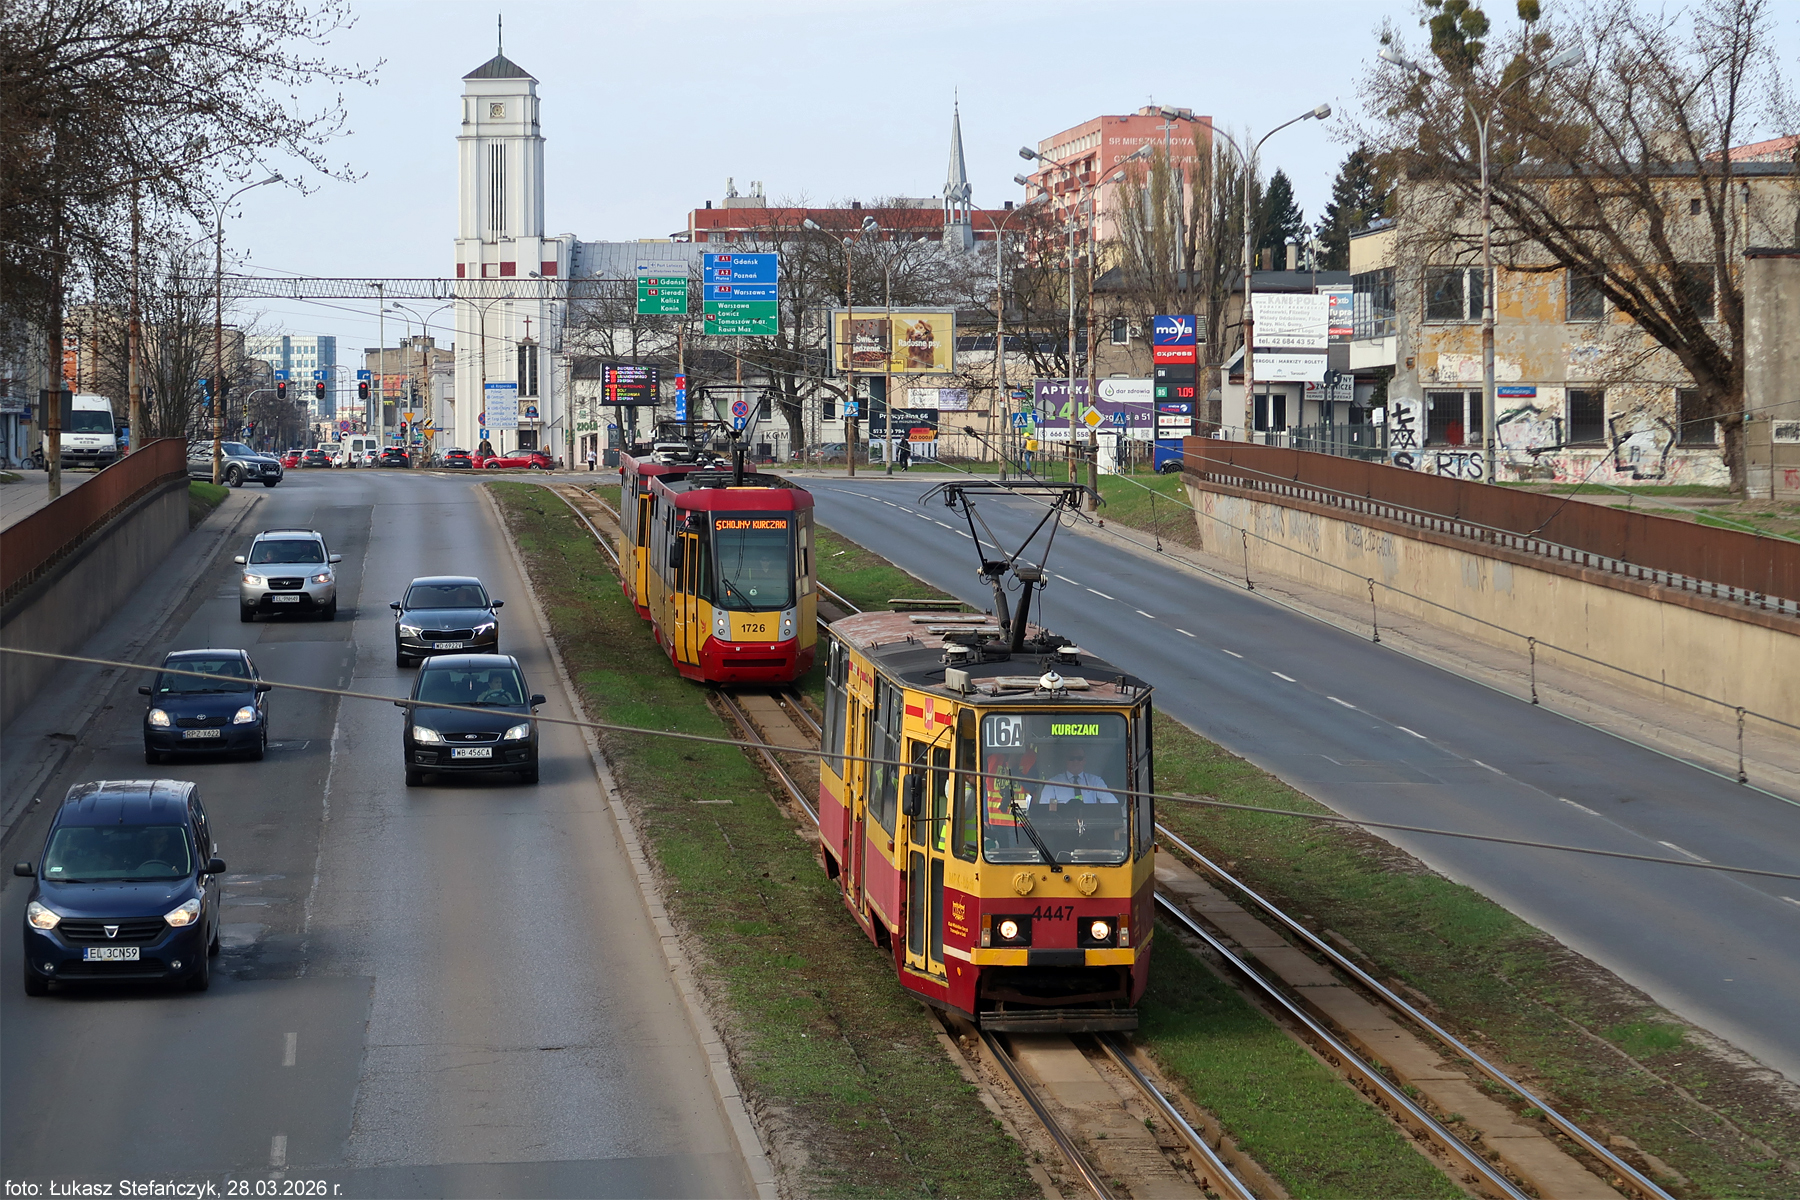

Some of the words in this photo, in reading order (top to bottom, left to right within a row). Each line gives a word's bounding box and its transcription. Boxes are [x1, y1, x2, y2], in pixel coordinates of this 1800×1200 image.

[898, 339, 927, 347] Radosne
[1041, 386, 1090, 395] APTKA
[722, 521, 750, 529] CHOJNY
[752, 520, 786, 529] KURCZAKI
[742, 624, 766, 632] 1726
[986, 717, 1023, 746] 16A
[1051, 724, 1099, 735] KURCZAKI
[1032, 906, 1074, 921] 4447
[90, 949, 102, 958] EL
[107, 948, 137, 958] 3CN59
